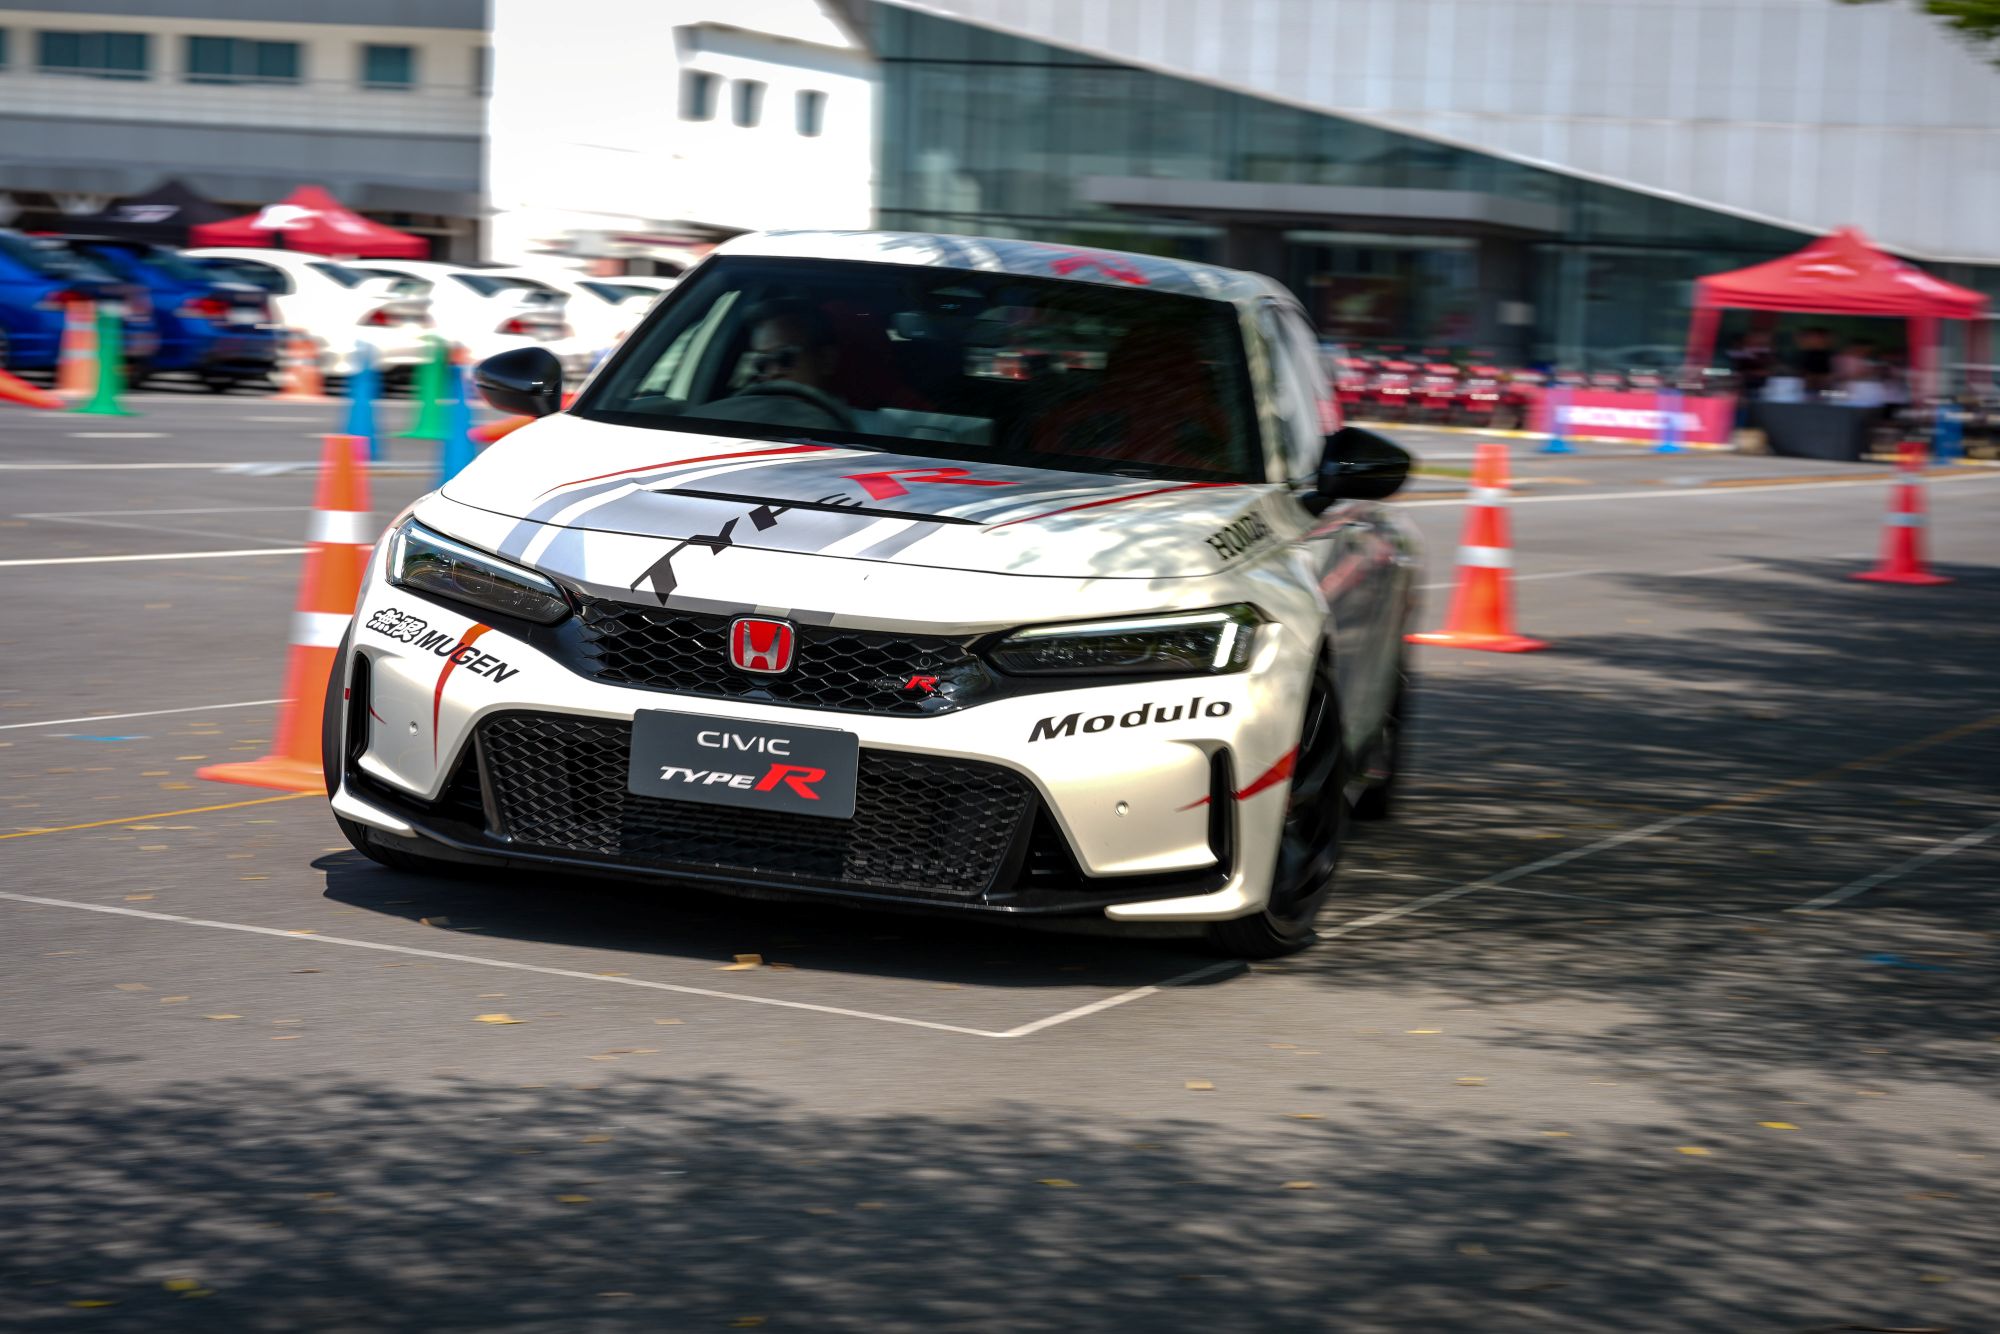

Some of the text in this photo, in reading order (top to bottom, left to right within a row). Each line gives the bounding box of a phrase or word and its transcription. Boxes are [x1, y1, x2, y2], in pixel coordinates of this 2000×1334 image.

[839, 467, 1024, 501] R
[366, 608, 521, 684] 無限 MUGEN
[1028, 696, 1233, 743] Modulo
[696, 730, 790, 756] CIVIC
[660, 762, 827, 801] TYPE R
